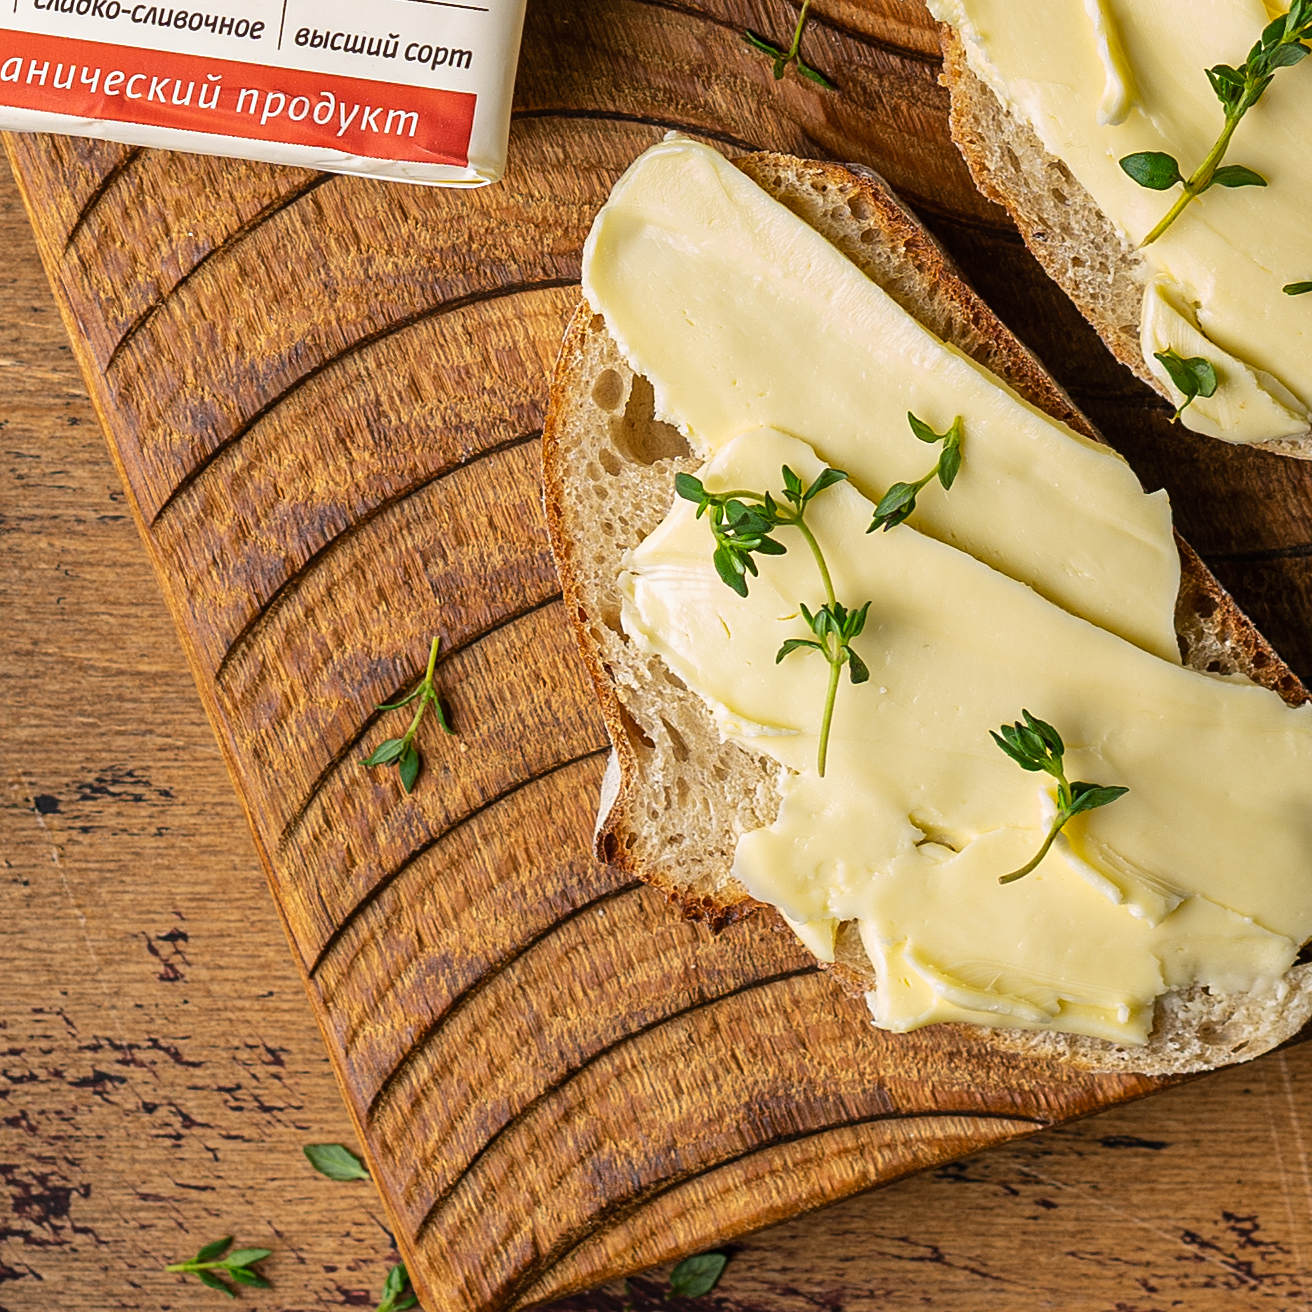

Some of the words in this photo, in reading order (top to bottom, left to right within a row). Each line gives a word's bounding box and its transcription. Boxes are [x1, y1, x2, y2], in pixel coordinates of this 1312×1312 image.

[294, 27, 400, 59] высший
[404, 42, 473, 70] сорт
[236, 88, 419, 137] продукт
